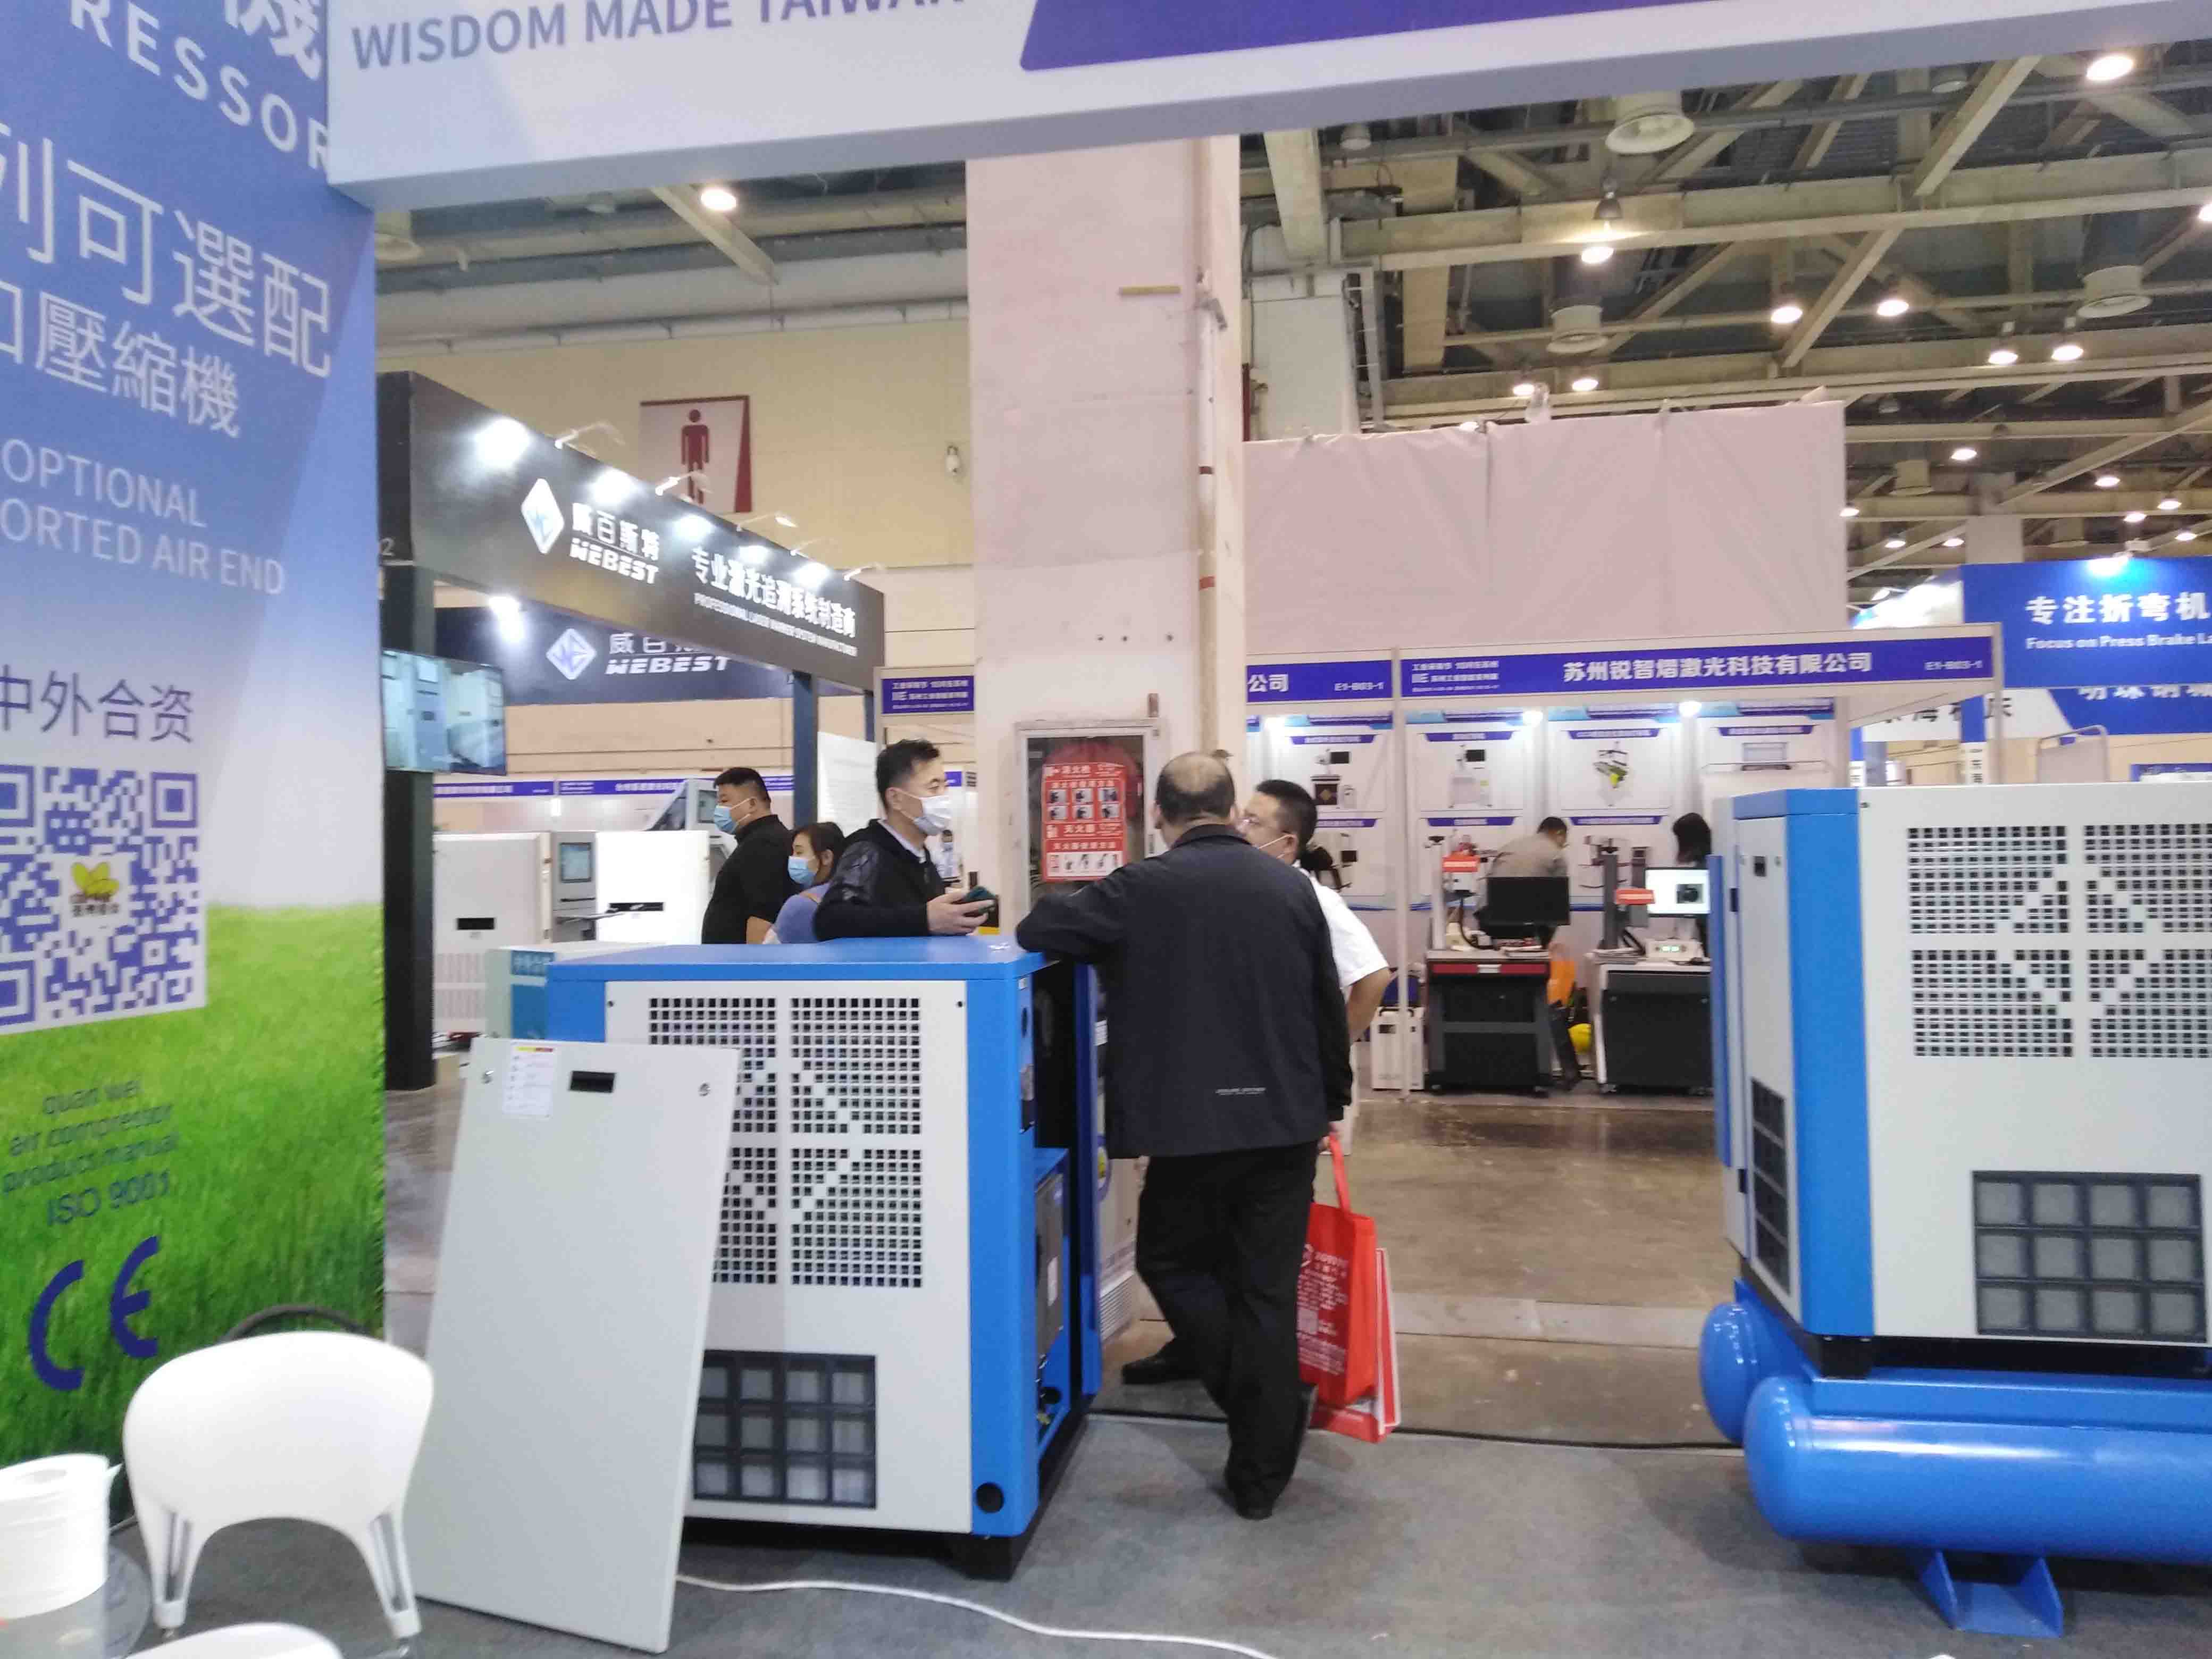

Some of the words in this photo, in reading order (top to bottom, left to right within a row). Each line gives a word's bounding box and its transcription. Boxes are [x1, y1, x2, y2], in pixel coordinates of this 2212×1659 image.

[351, 6, 566, 71] WISDOM
[584, 0, 732, 42] MADE
[2, 439, 207, 528] OPTIONAL
[152, 534, 210, 580] AIR
[220, 548, 286, 594] END
[569, 537, 660, 584] WEBEST
[606, 655, 732, 675] WEBEST
[1247, 673, 1289, 692] 公司
[47, 1187, 102, 1226] ISO
